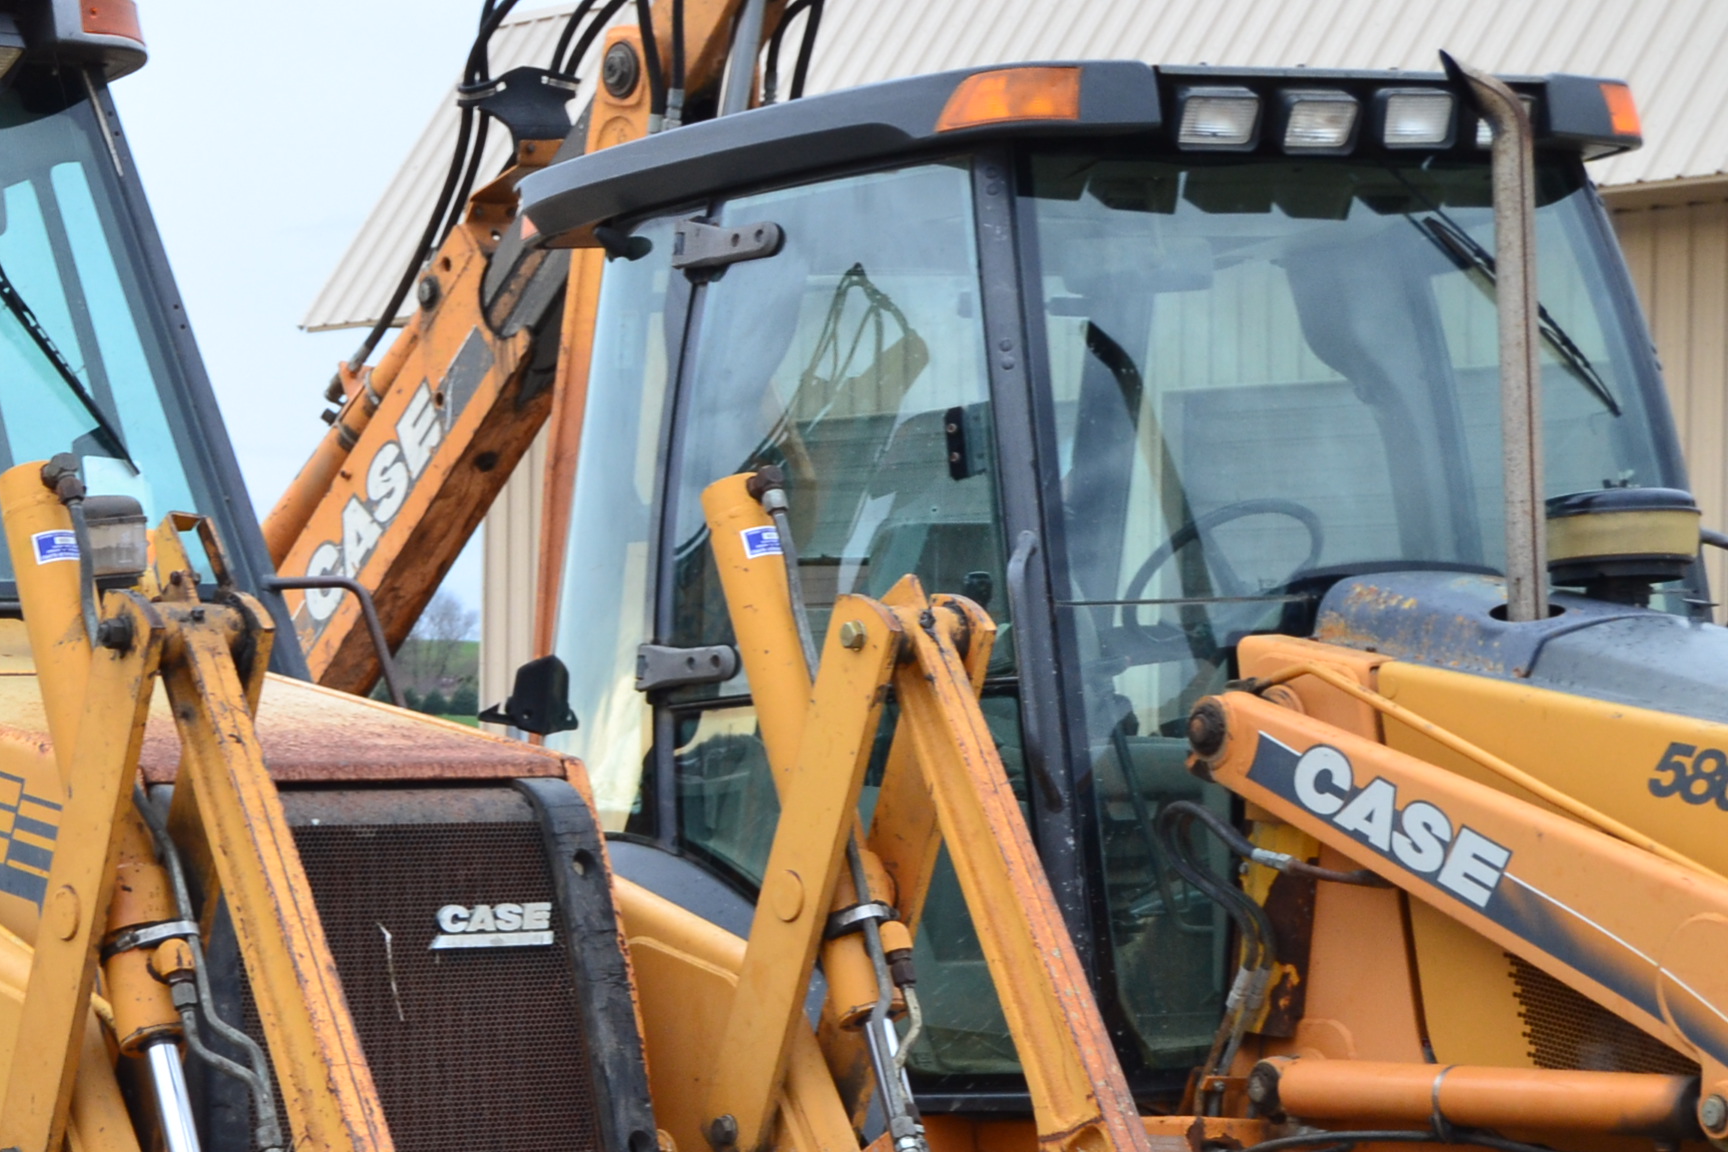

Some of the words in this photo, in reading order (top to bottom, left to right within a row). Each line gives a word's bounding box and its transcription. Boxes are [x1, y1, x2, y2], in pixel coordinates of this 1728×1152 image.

[306, 380, 441, 620] CASE
[1294, 745, 1512, 909] CASE
[1648, 741, 1728, 811] 58
[436, 902, 552, 933] CASE
